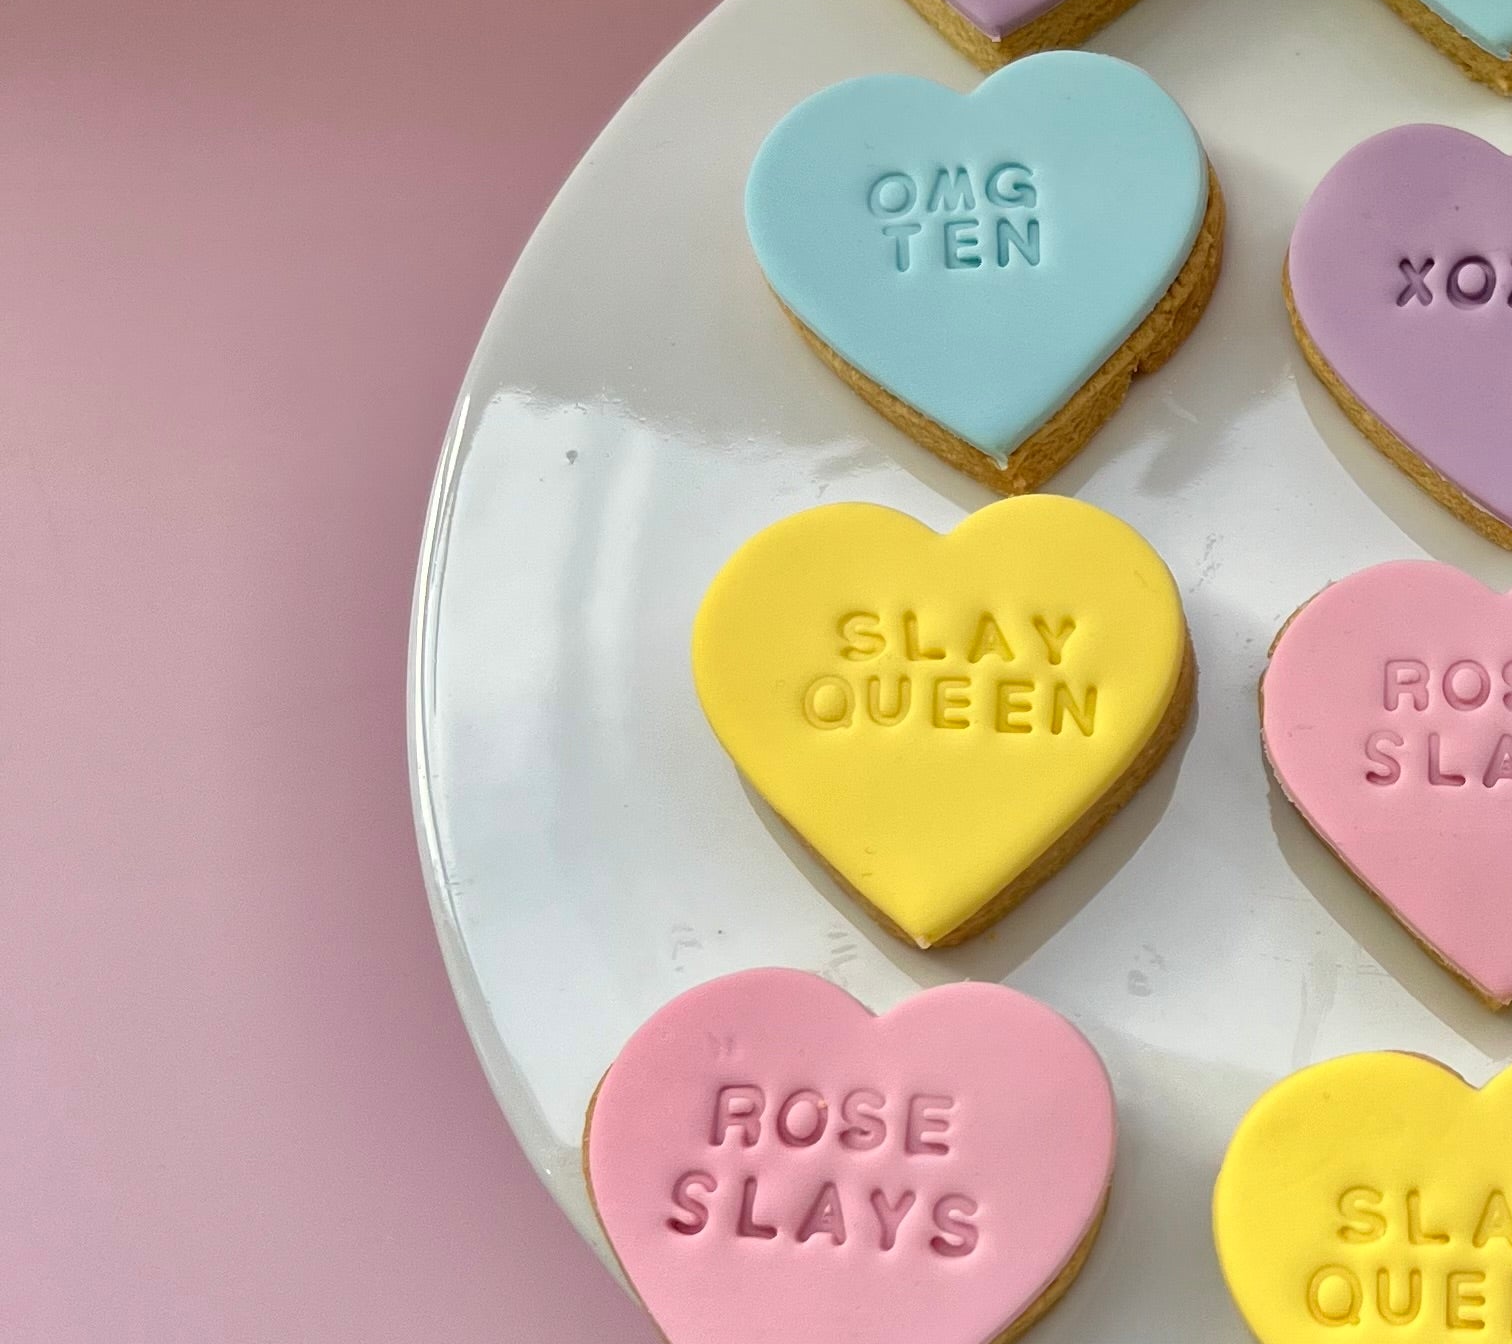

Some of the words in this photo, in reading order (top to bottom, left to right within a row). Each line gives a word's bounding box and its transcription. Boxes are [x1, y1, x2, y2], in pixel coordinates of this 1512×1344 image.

[868, 162, 1038, 218] OMG
[882, 219, 1041, 272] TEN
[836, 611, 1077, 664] SLAY
[803, 673, 1098, 737] QUEEN
[710, 1083, 956, 1157] ROSE
[667, 1169, 980, 1256] SLAYS
